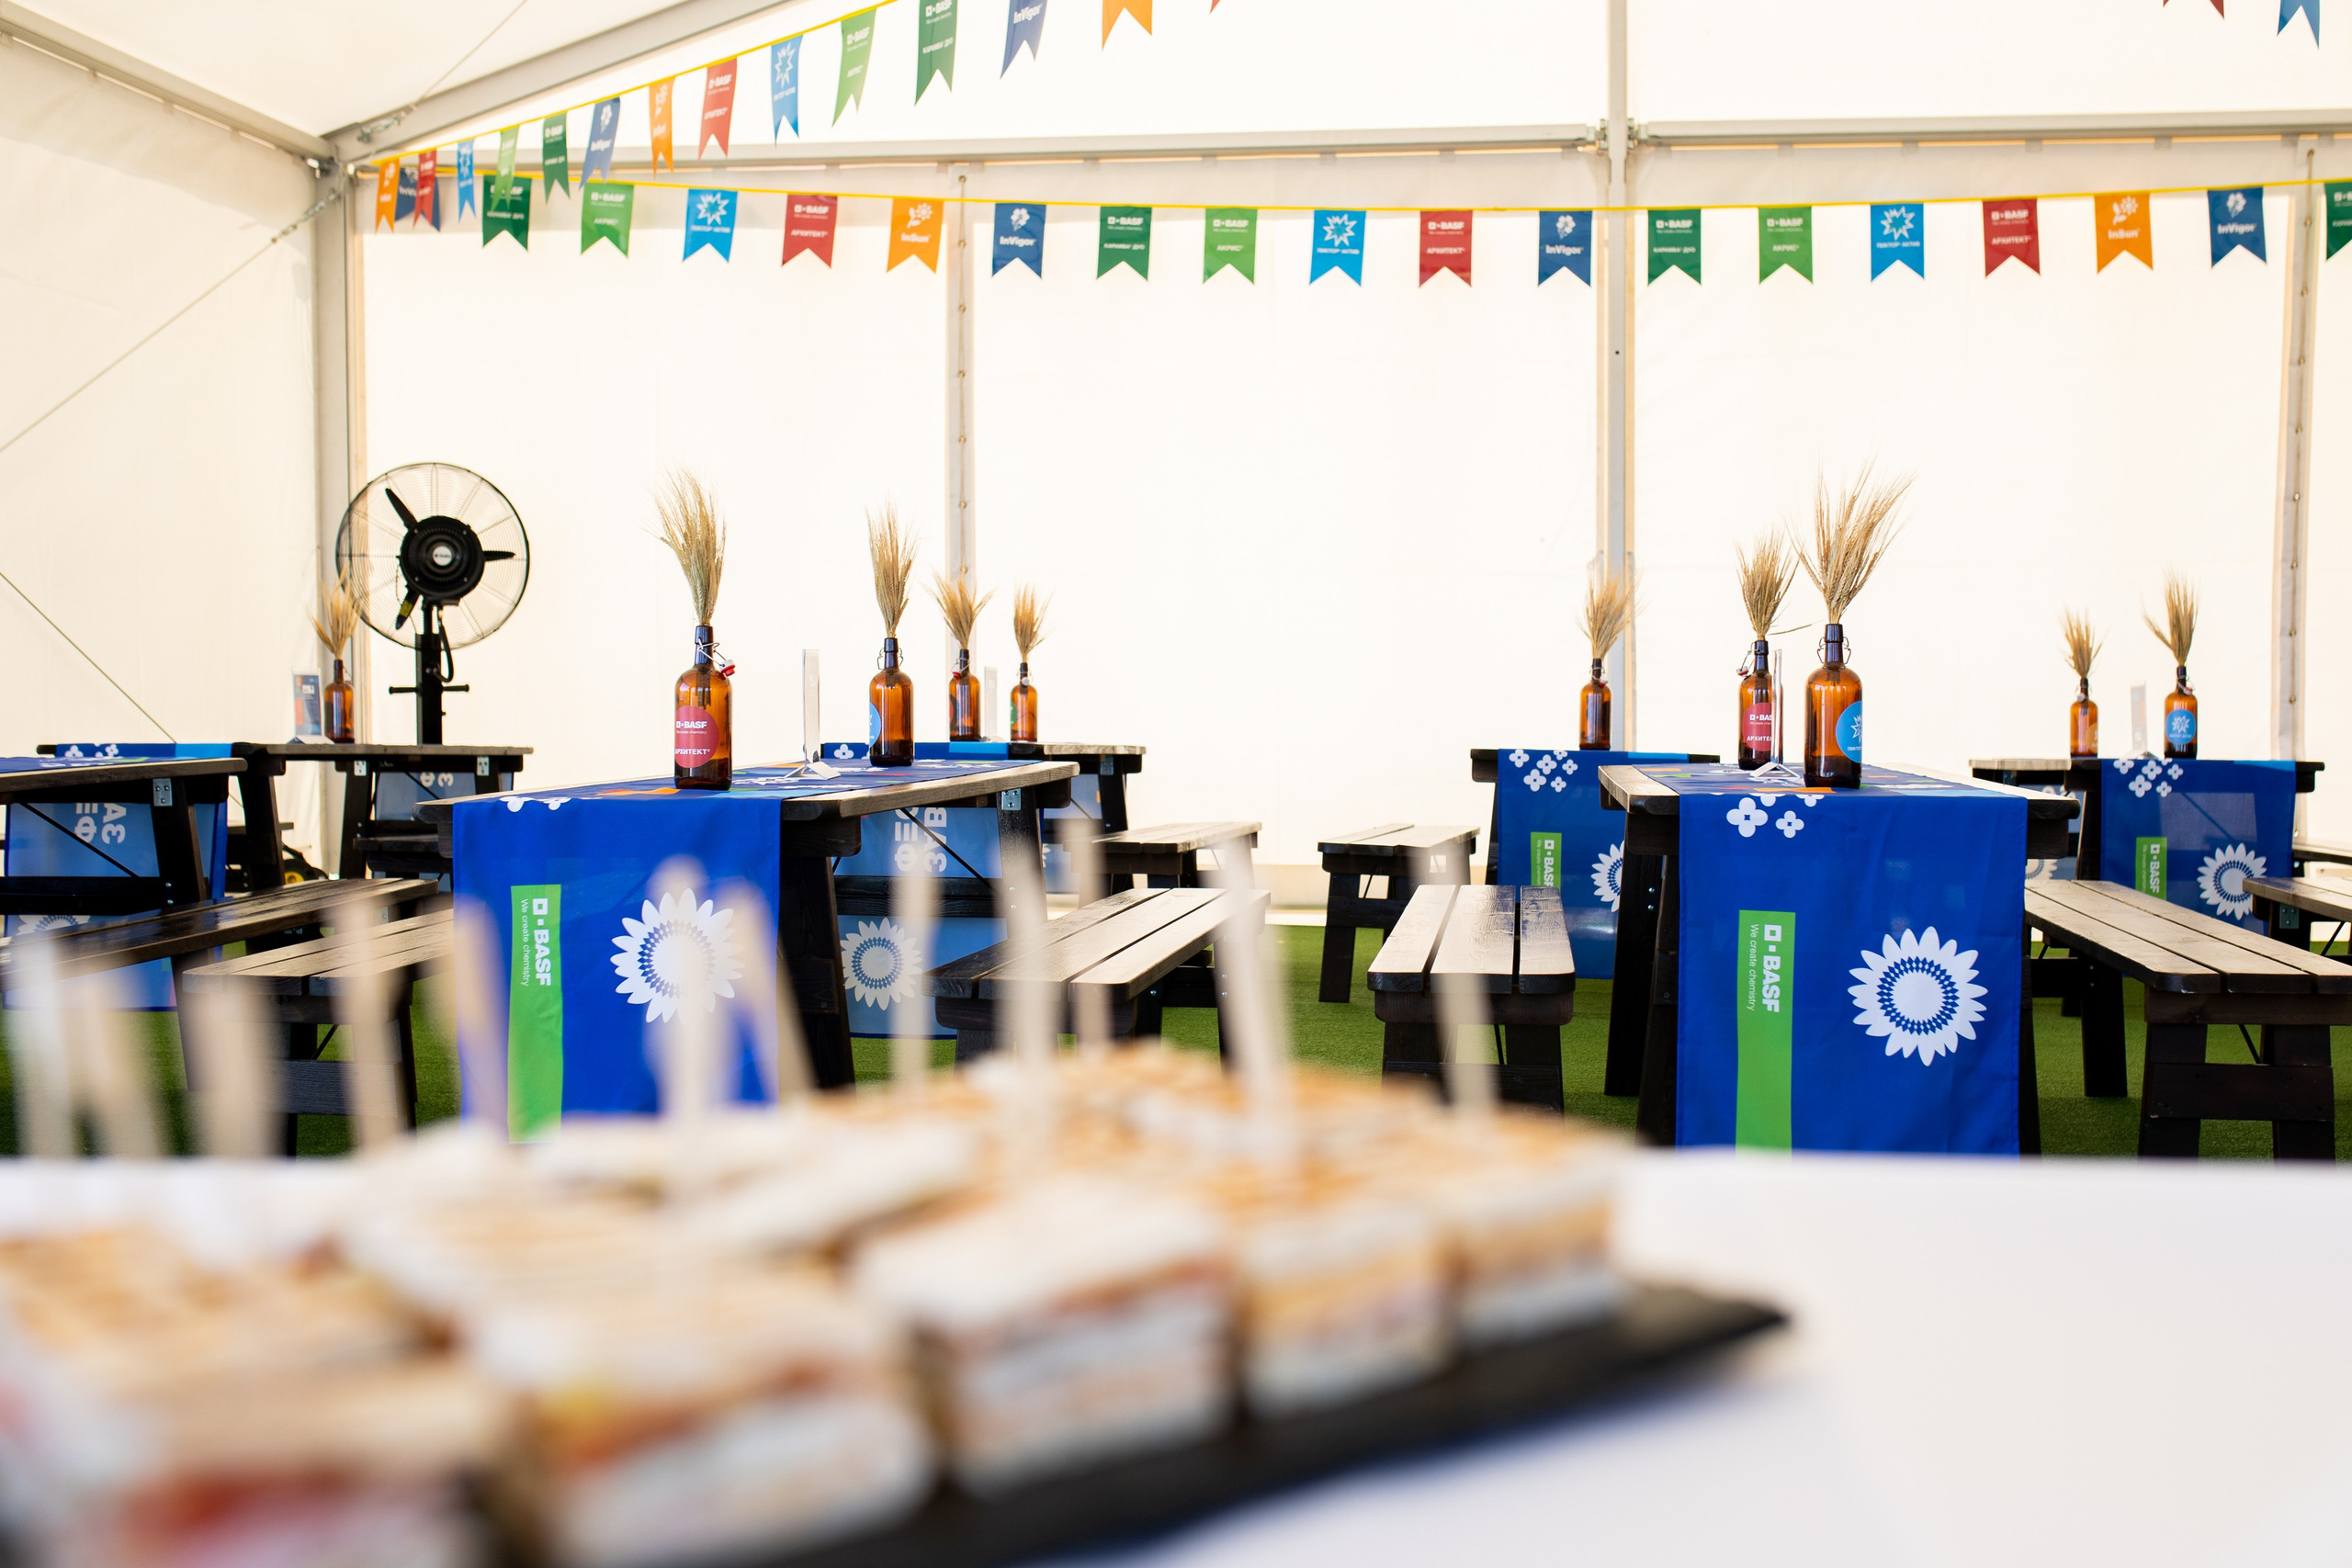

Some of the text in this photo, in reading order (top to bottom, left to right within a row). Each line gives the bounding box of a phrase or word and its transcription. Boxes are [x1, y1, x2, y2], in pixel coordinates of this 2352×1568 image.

[935, 0, 952, 14] BASF
[806, 205, 830, 214] BASF
[2004, 209, 2029, 220] BASF
[1119, 217, 1144, 226] BASF
[1225, 219, 1250, 228] BASF
[1440, 221, 1464, 230] BASF
[1668, 219, 1692, 229] BASF
[1779, 218, 1804, 227] BASF
[684, 721, 707, 729] BASF
[1544, 857, 1555, 886] BASF
[2150, 861, 2160, 893] BASF
[521, 898, 531, 987] We create chemistry
[534, 930, 551, 986] BASF
[1747, 924, 1759, 1011] We create chemistry
[1762, 955, 1781, 1012] BASF
